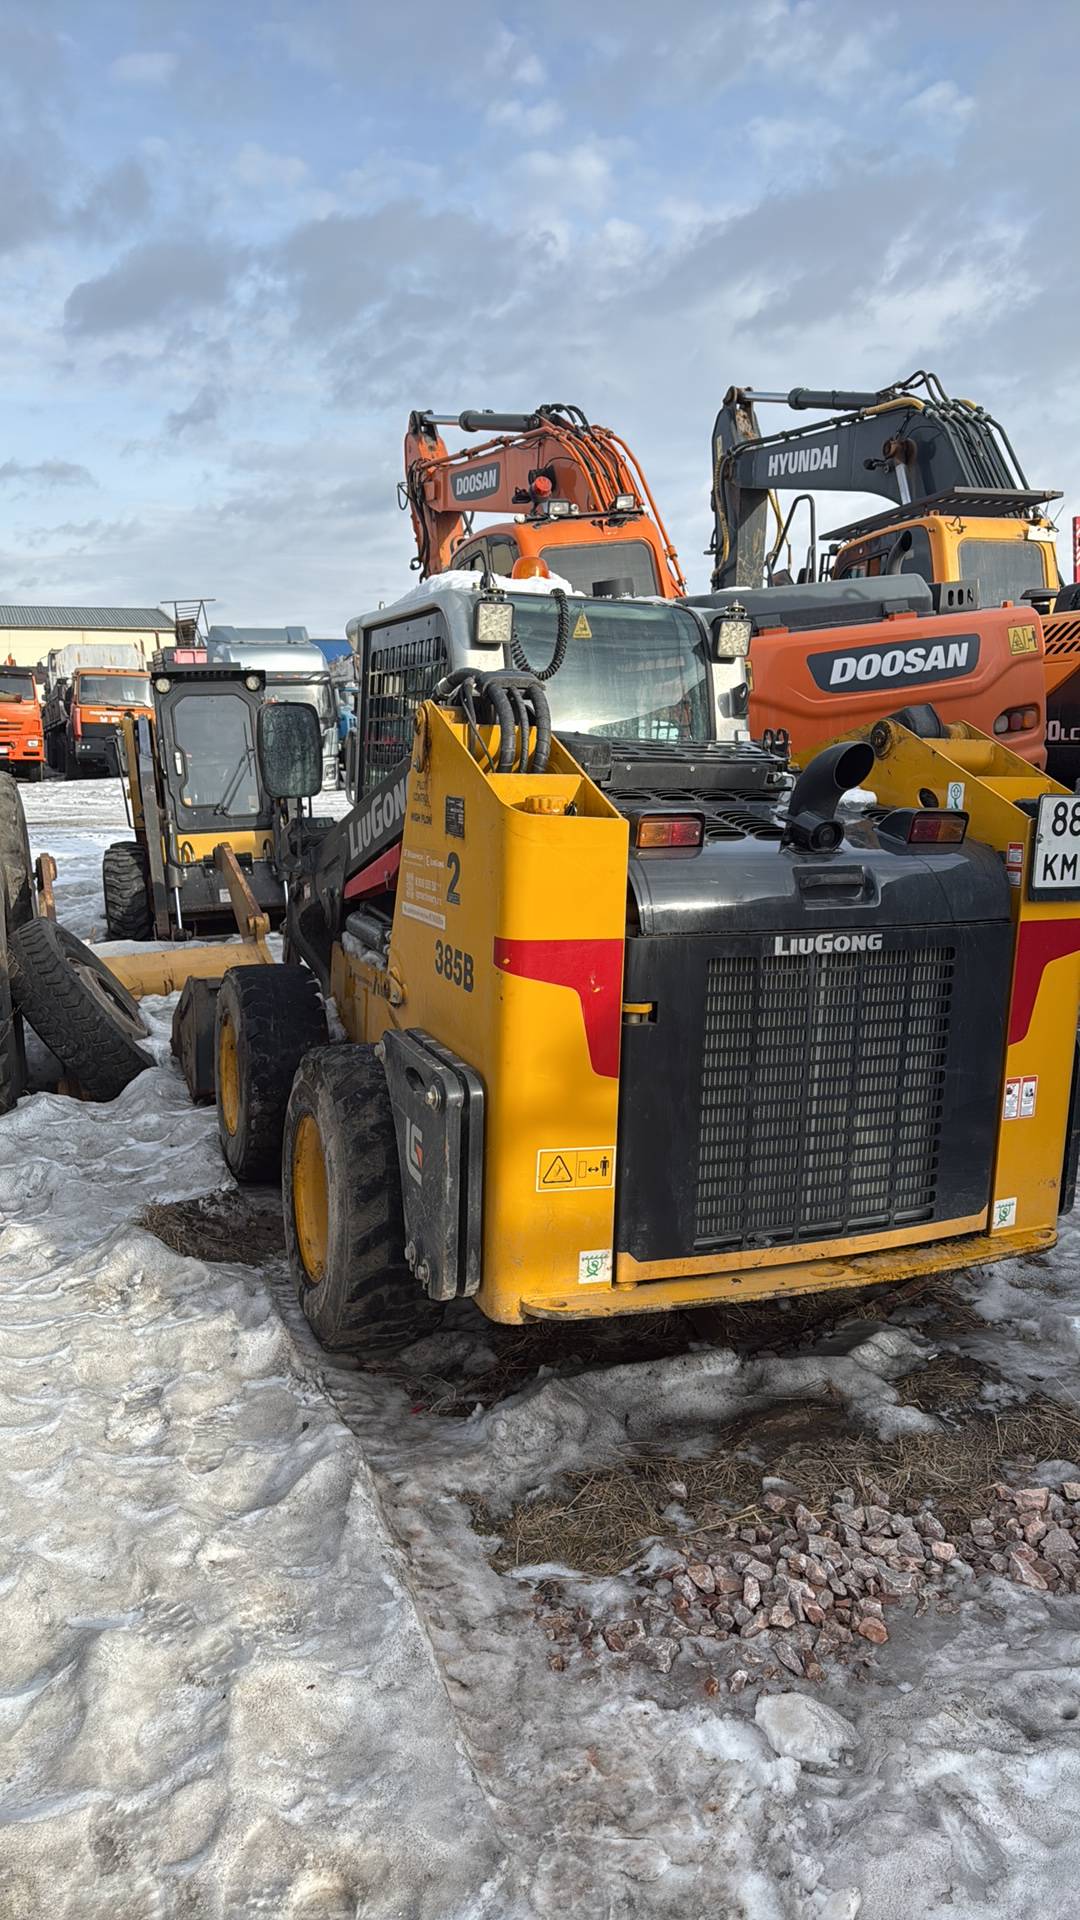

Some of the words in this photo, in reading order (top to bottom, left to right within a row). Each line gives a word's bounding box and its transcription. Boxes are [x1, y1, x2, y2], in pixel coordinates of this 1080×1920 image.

[767, 444, 839, 477] HYUNDAI
[456, 469, 497, 496] DOOSAN
[829, 642, 969, 685] DOOSAN
[1047, 719, 1080, 741] 0LC
[348, 778, 406, 860] LIUGON
[1051, 801, 1080, 837] 88
[446, 851, 461, 906] 2
[1042, 853, 1078, 881] KM
[434, 939, 474, 993] 385B
